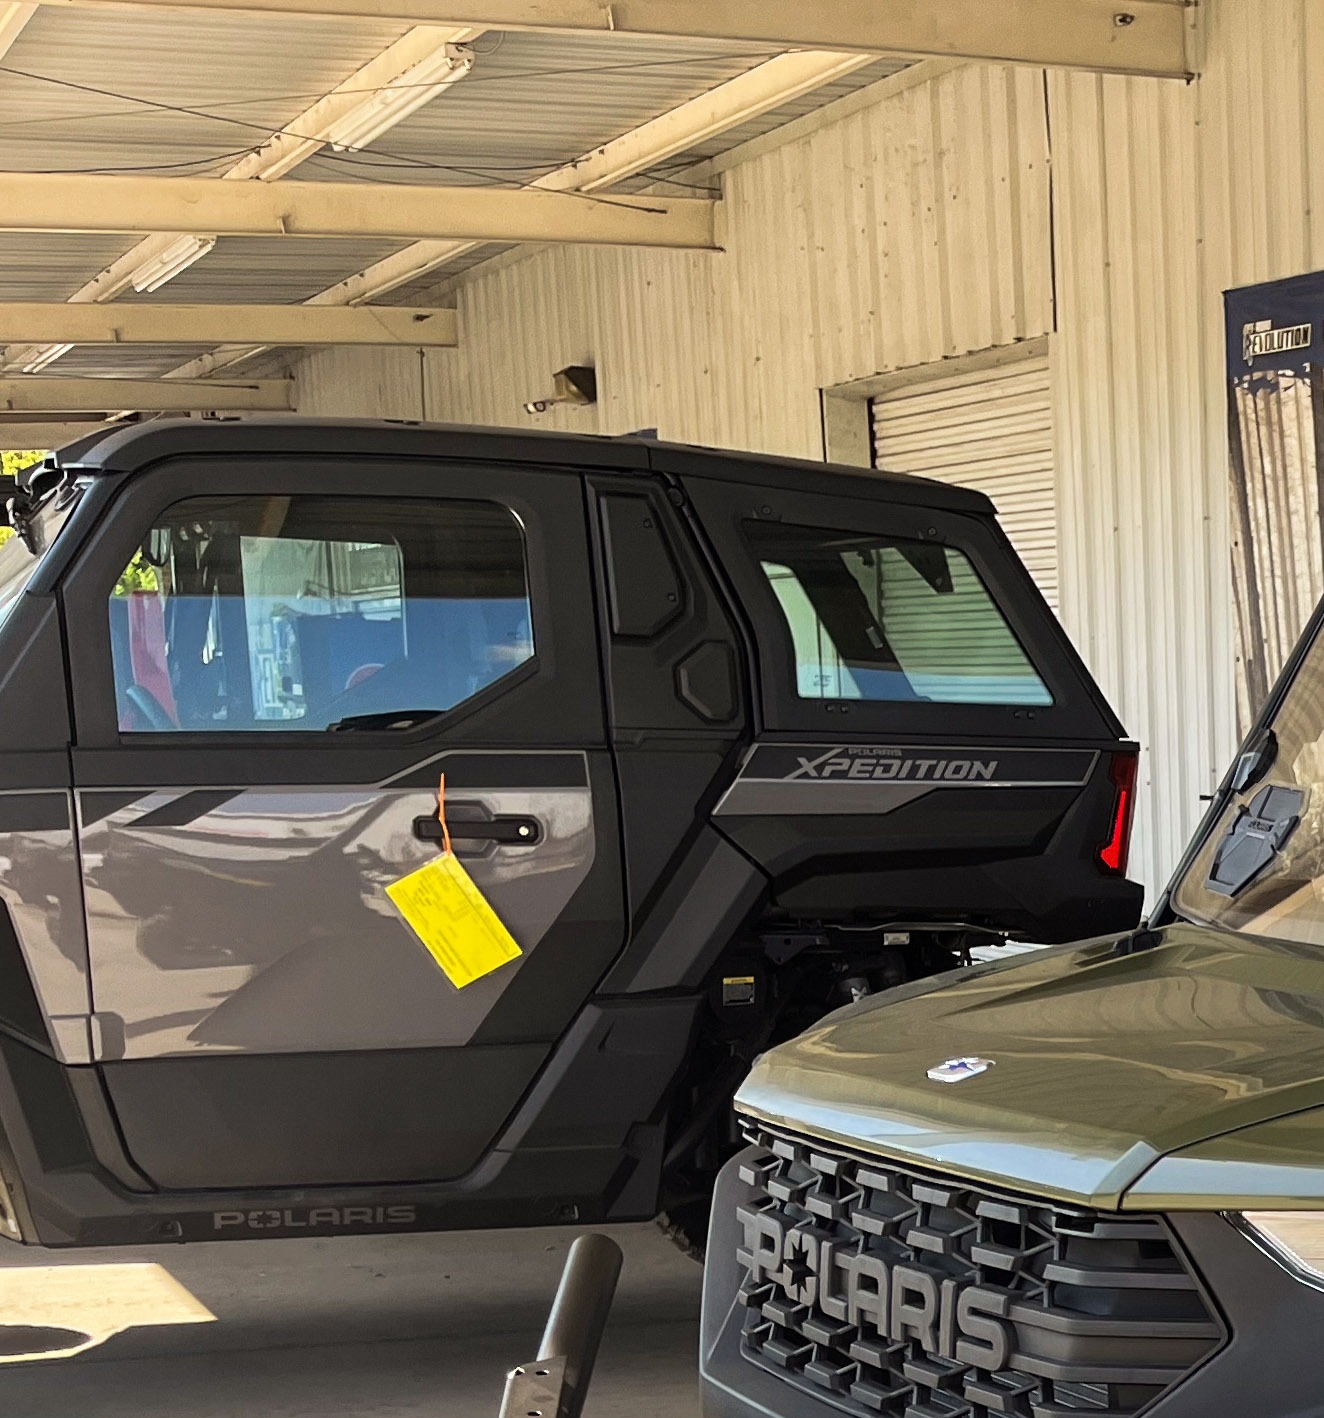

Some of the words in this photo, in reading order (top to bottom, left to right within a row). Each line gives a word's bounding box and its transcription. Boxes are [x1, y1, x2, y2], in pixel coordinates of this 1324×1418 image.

[783, 748, 998, 780] XPEDITION
[213, 1205, 417, 1230] POLARIS
[748, 1209, 1010, 1372] POLARIS
